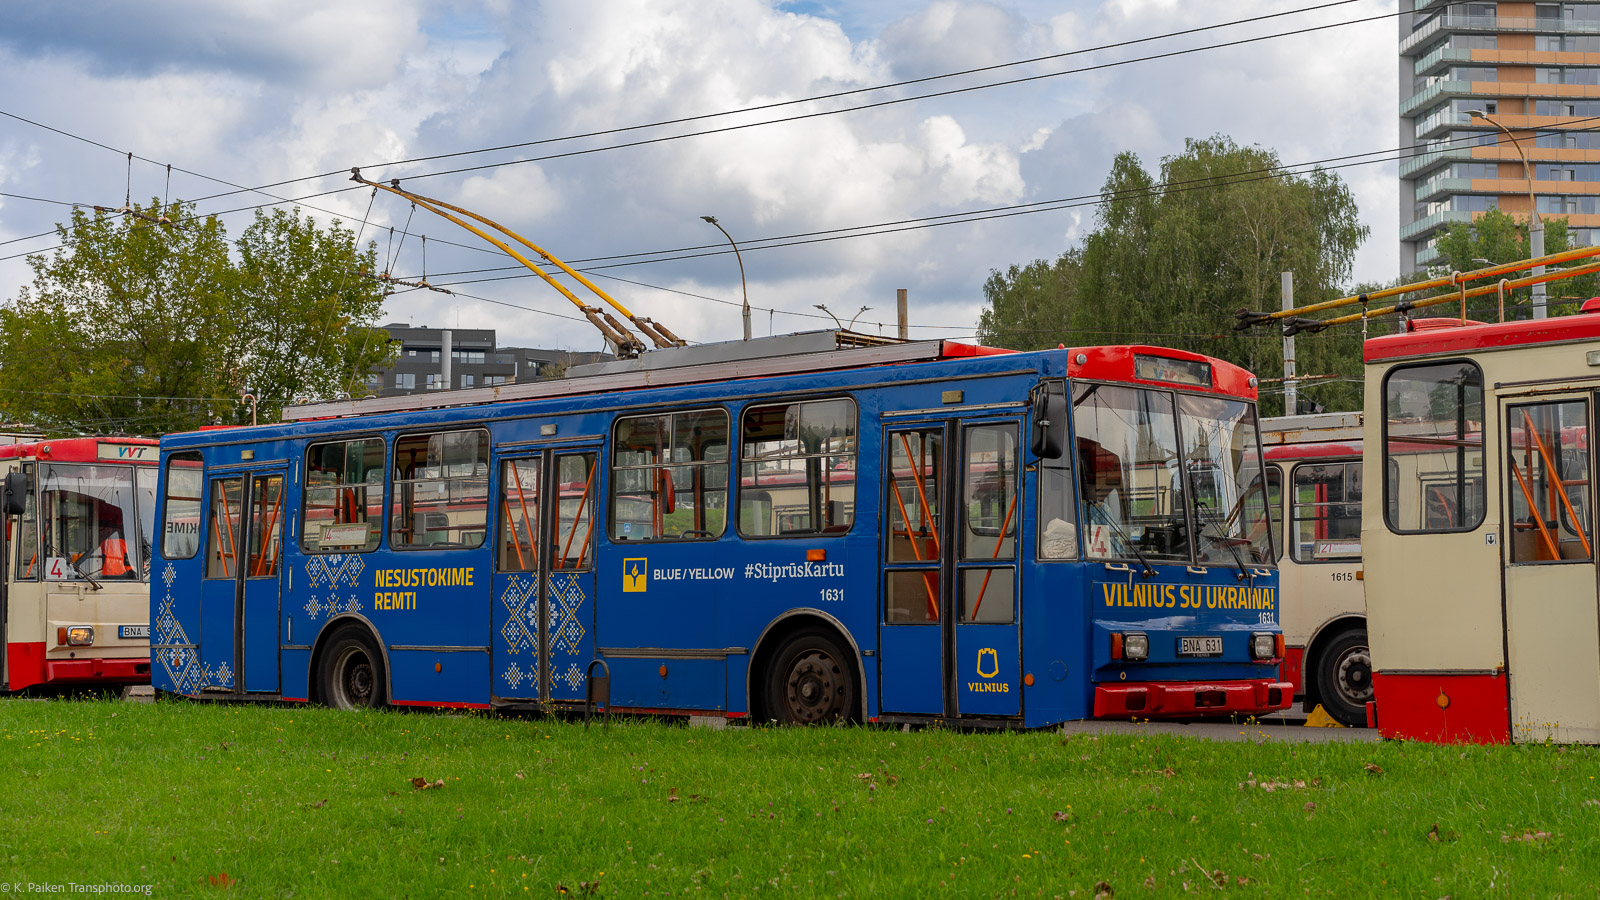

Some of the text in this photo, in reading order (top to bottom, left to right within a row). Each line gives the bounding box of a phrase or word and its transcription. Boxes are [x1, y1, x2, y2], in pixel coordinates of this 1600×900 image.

[118, 446, 148, 458] VVT
[325, 527, 332, 541] 4
[1091, 525, 1107, 557] 4
[50, 559, 63, 578] 4
[744, 561, 845, 583] #StiprūsKartu
[375, 567, 474, 587] NESUSTOKIME
[1331, 572, 1353, 581] 1615
[374, 591, 417, 610] REMTI
[819, 588, 845, 601] 1631
[1102, 583, 1275, 610] VILNIUS SU UKRAINA!
[1258, 611, 1275, 624] 1631
[124, 627, 142, 636] BNA
[1183, 639, 1221, 652] BNA 631
[967, 682, 1009, 693] VILNIUS
